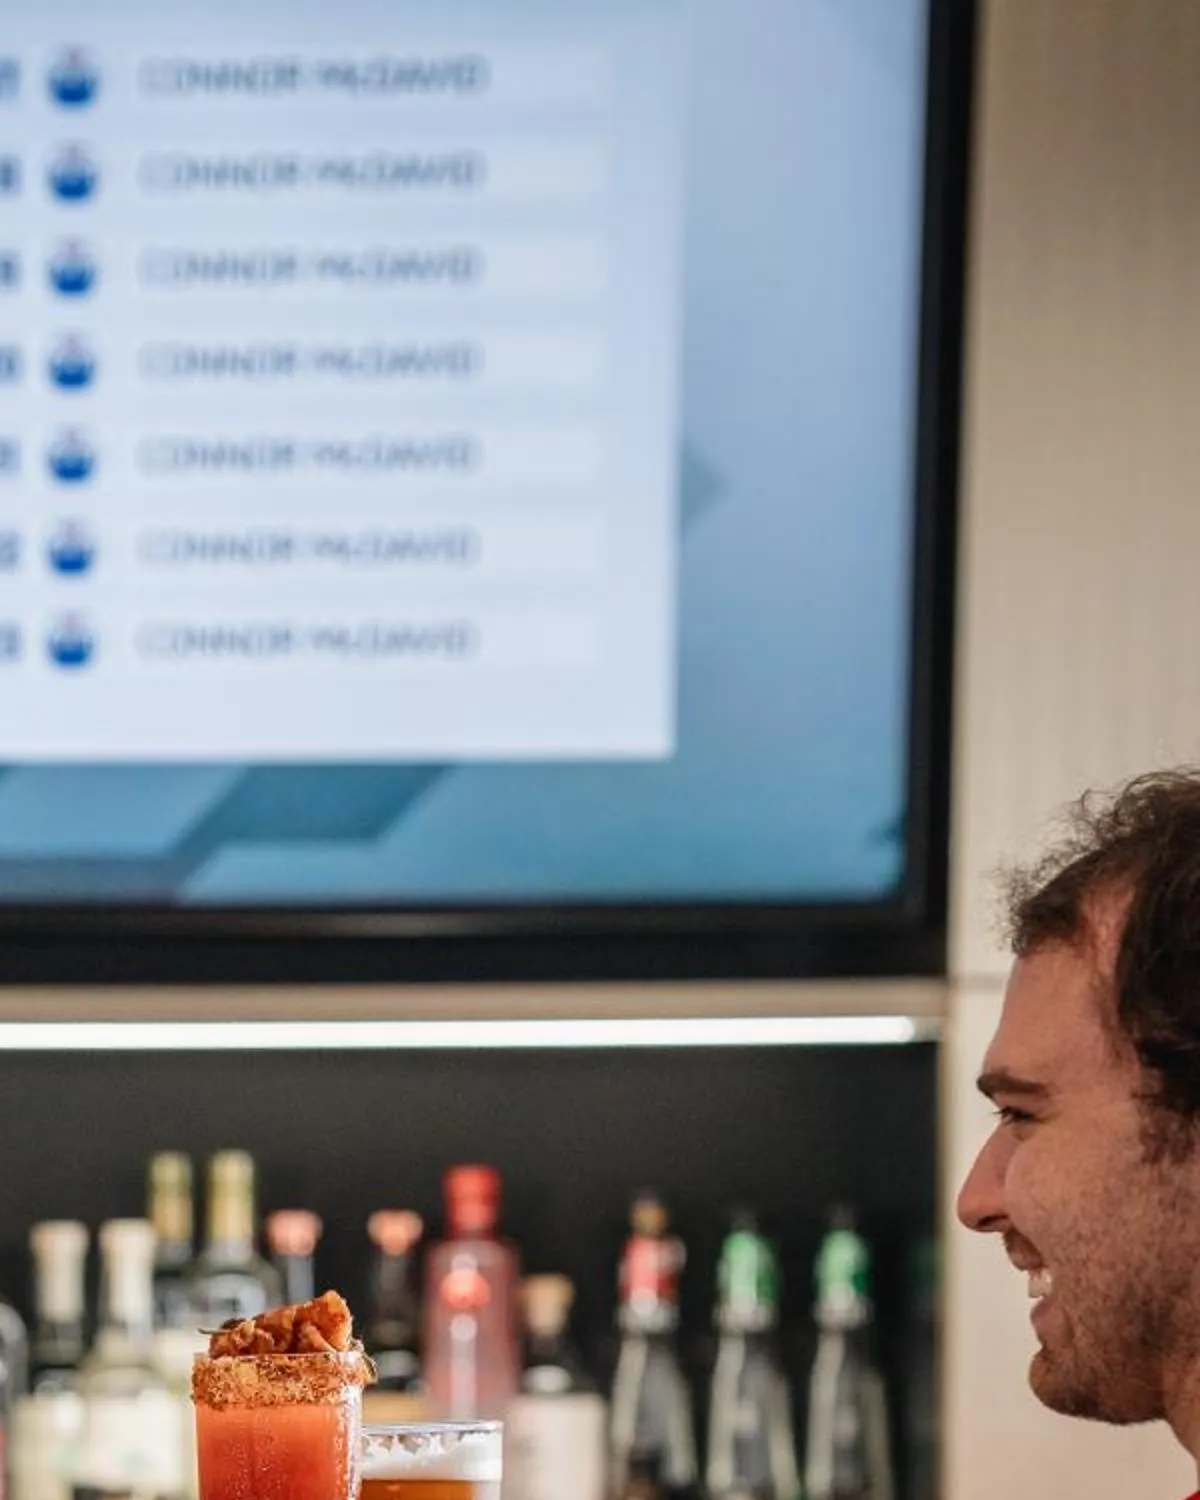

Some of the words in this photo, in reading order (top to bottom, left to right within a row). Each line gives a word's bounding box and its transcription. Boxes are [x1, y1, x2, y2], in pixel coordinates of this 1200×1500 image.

[142, 58, 303, 95] CONNOR
[142, 156, 302, 191] CONNOR
[142, 251, 302, 286] CONNOR
[142, 344, 301, 378] CONNOR
[142, 438, 300, 473] CONNOR
[142, 531, 300, 567] CONNOR
[142, 624, 299, 660] CONNOR
